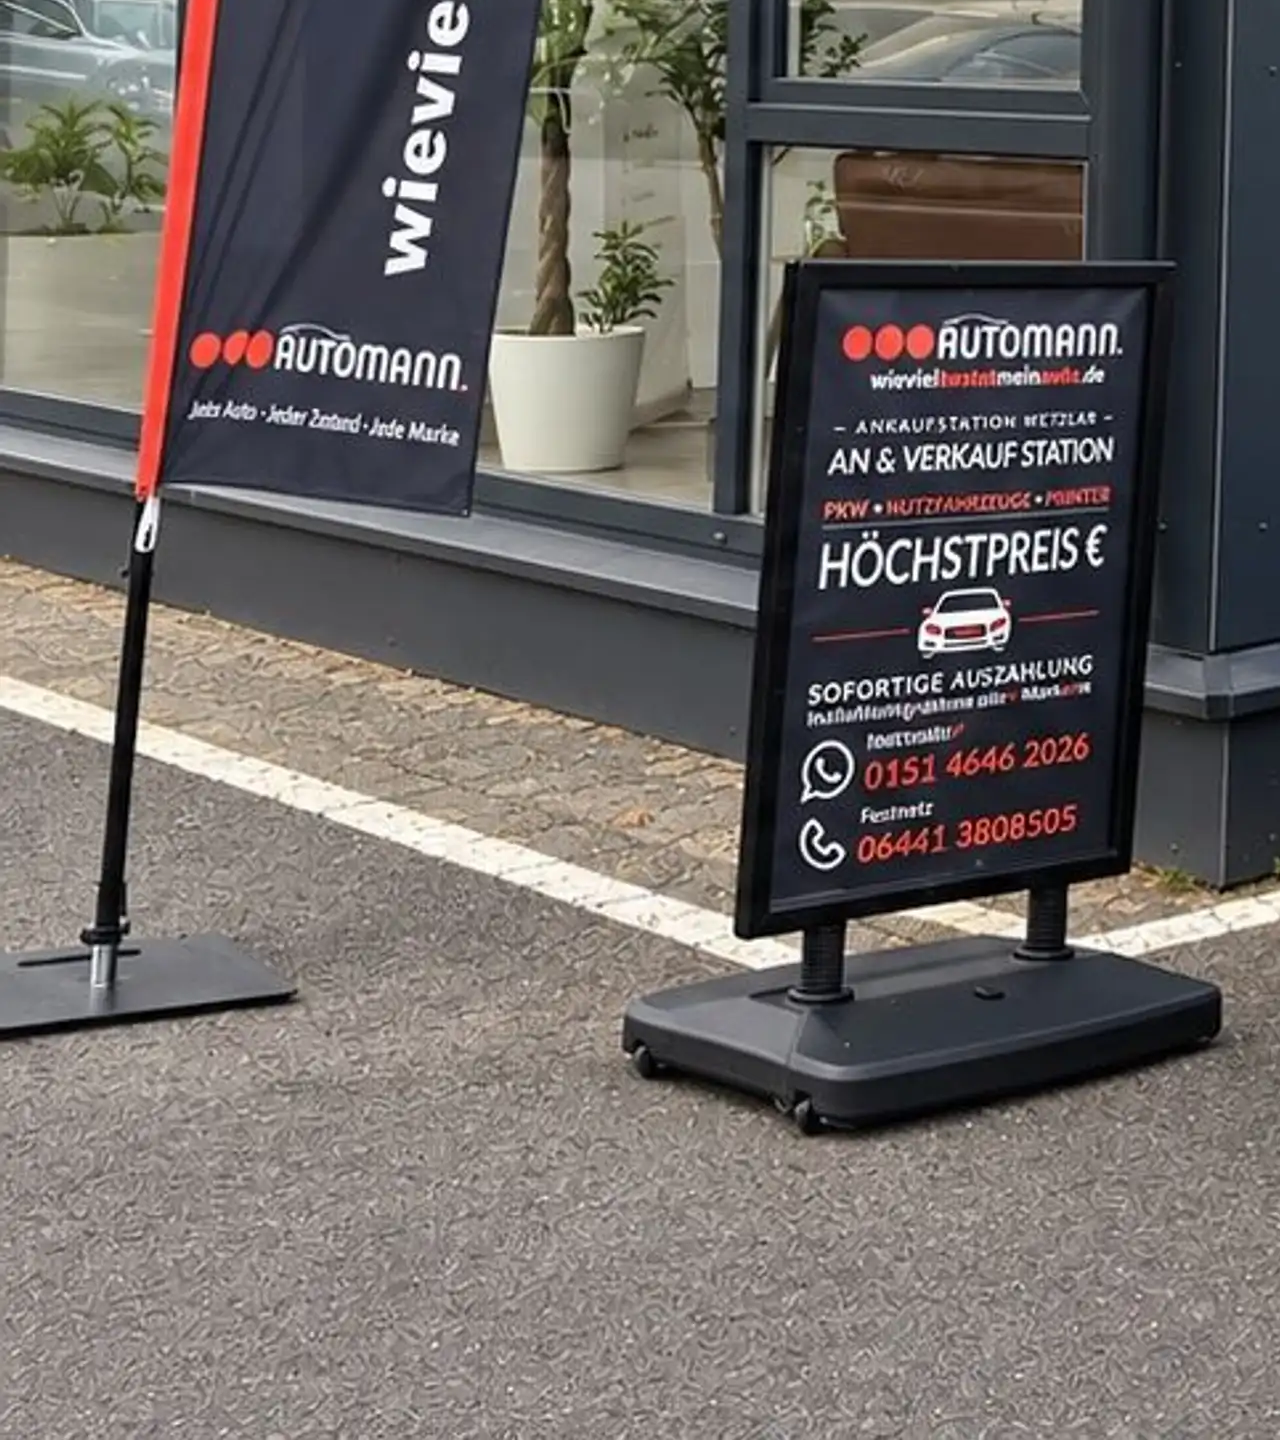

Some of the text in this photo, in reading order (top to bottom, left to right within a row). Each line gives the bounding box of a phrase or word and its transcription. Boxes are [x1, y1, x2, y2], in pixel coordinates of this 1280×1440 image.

[826, 436, 1116, 477] AN & VERKAUF STATION
[822, 499, 872, 521] PKW
[817, 523, 1108, 591] HÖCHSTPREIS €
[807, 654, 1094, 707] SOFORTIGE AUSZAHLUNG
[863, 731, 1091, 791] 0151 4646 2026
[857, 804, 1079, 864] 06441 3808505
